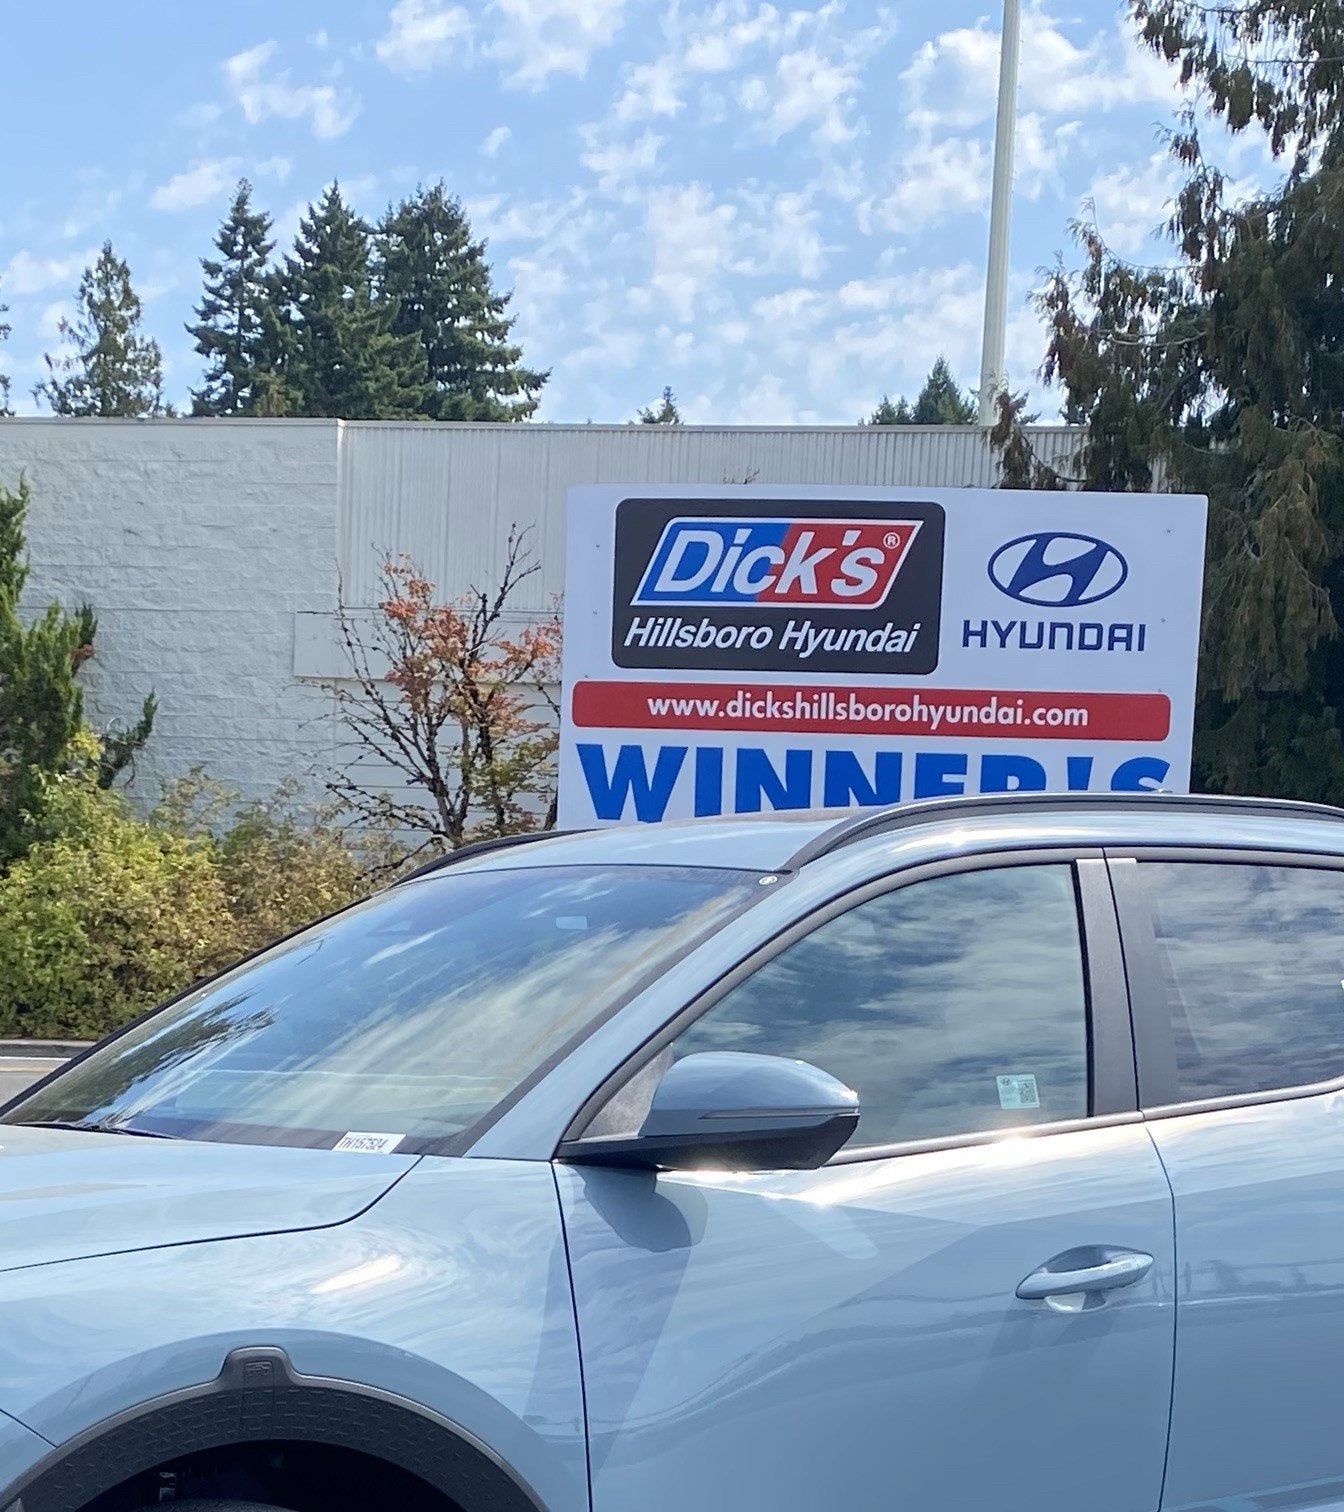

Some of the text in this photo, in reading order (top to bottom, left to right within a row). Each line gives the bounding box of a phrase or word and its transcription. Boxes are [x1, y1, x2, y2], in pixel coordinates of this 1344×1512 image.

[623, 616, 921, 658] Hillsboro Hyundai
[961, 619, 1146, 652] HYUNDAI
[647, 690, 1089, 730] www.dickshillsborohyundai.com
